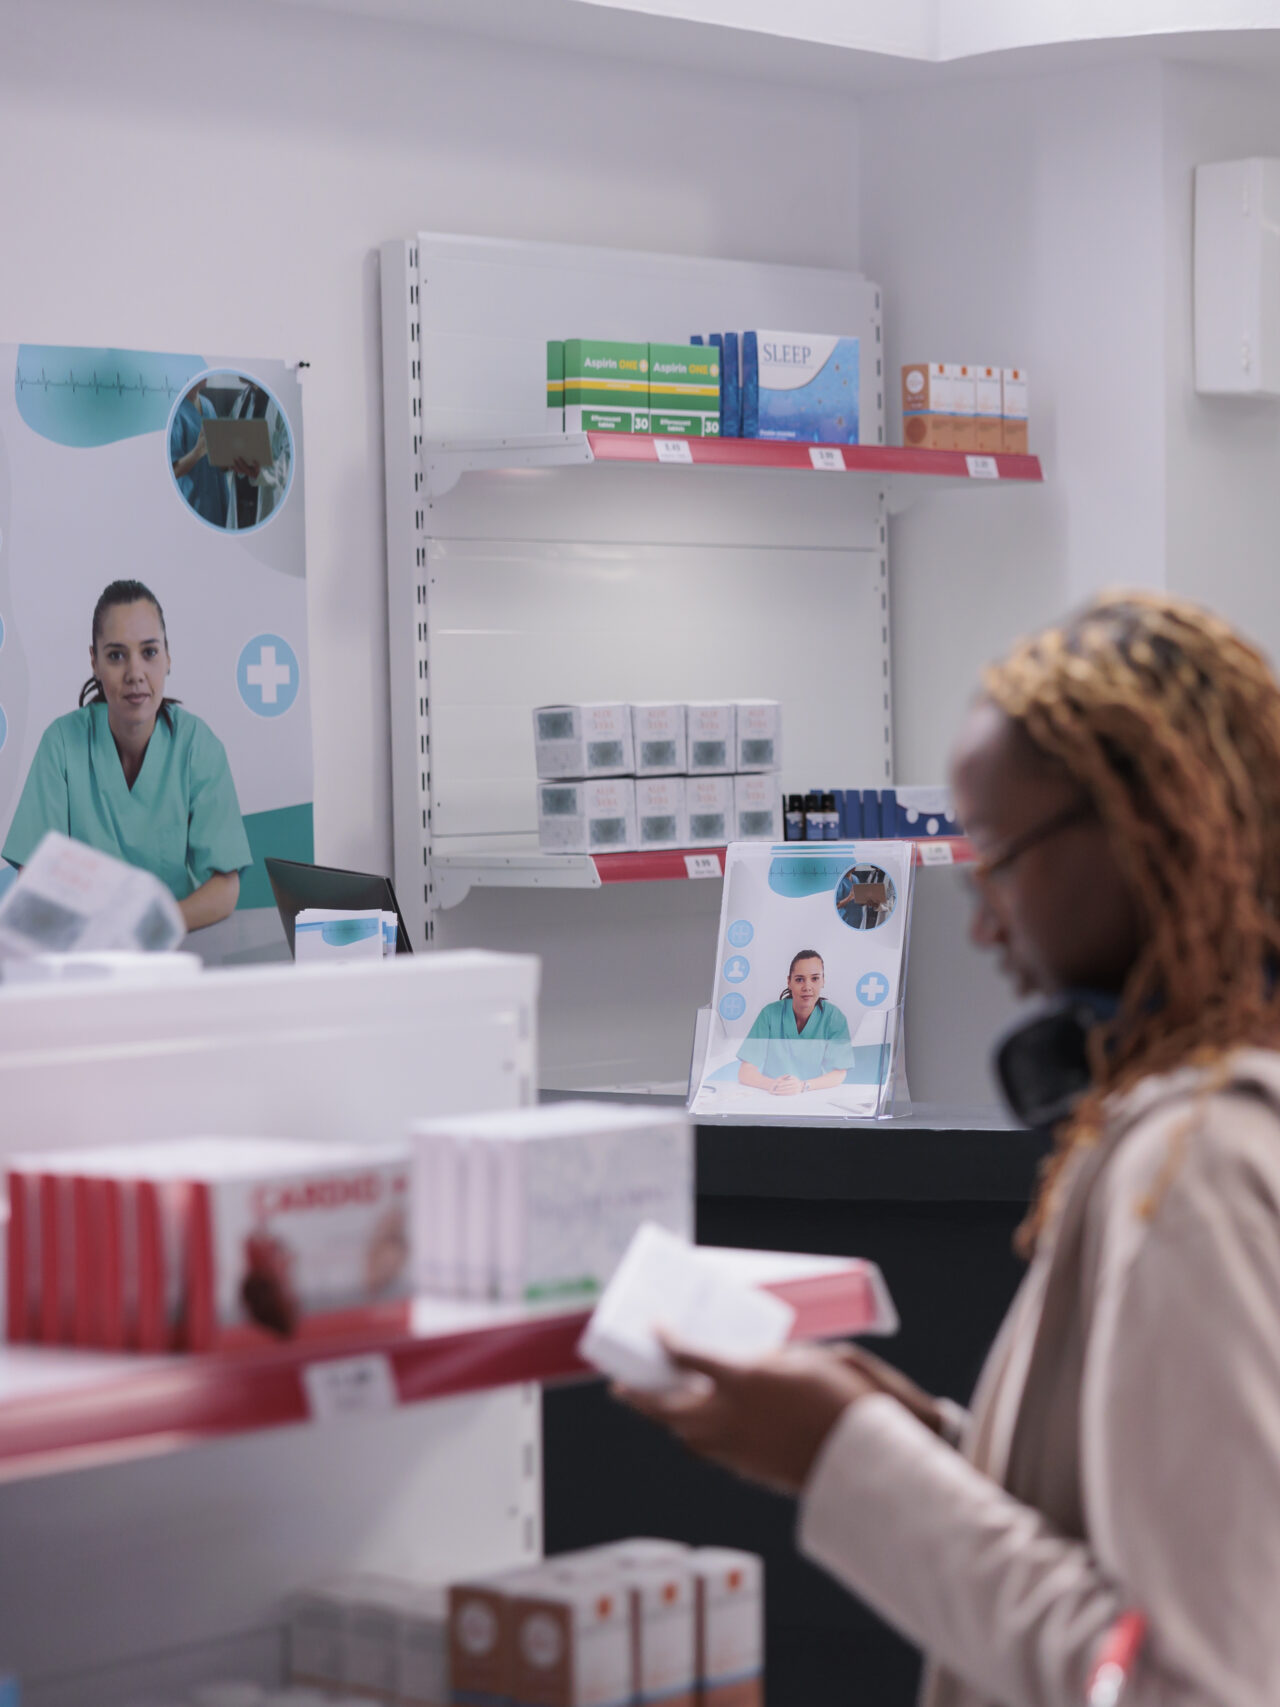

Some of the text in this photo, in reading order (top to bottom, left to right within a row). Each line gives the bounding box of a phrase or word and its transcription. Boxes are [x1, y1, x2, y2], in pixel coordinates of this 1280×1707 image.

[763, 343, 812, 364] SLEEP
[584, 357, 638, 370] Aspirin ONE
[653, 362, 708, 374] Aspirin ONE
[634, 418, 649, 430] 30
[705, 422, 719, 434] 30
[253, 1172, 380, 1216] CARDIO
